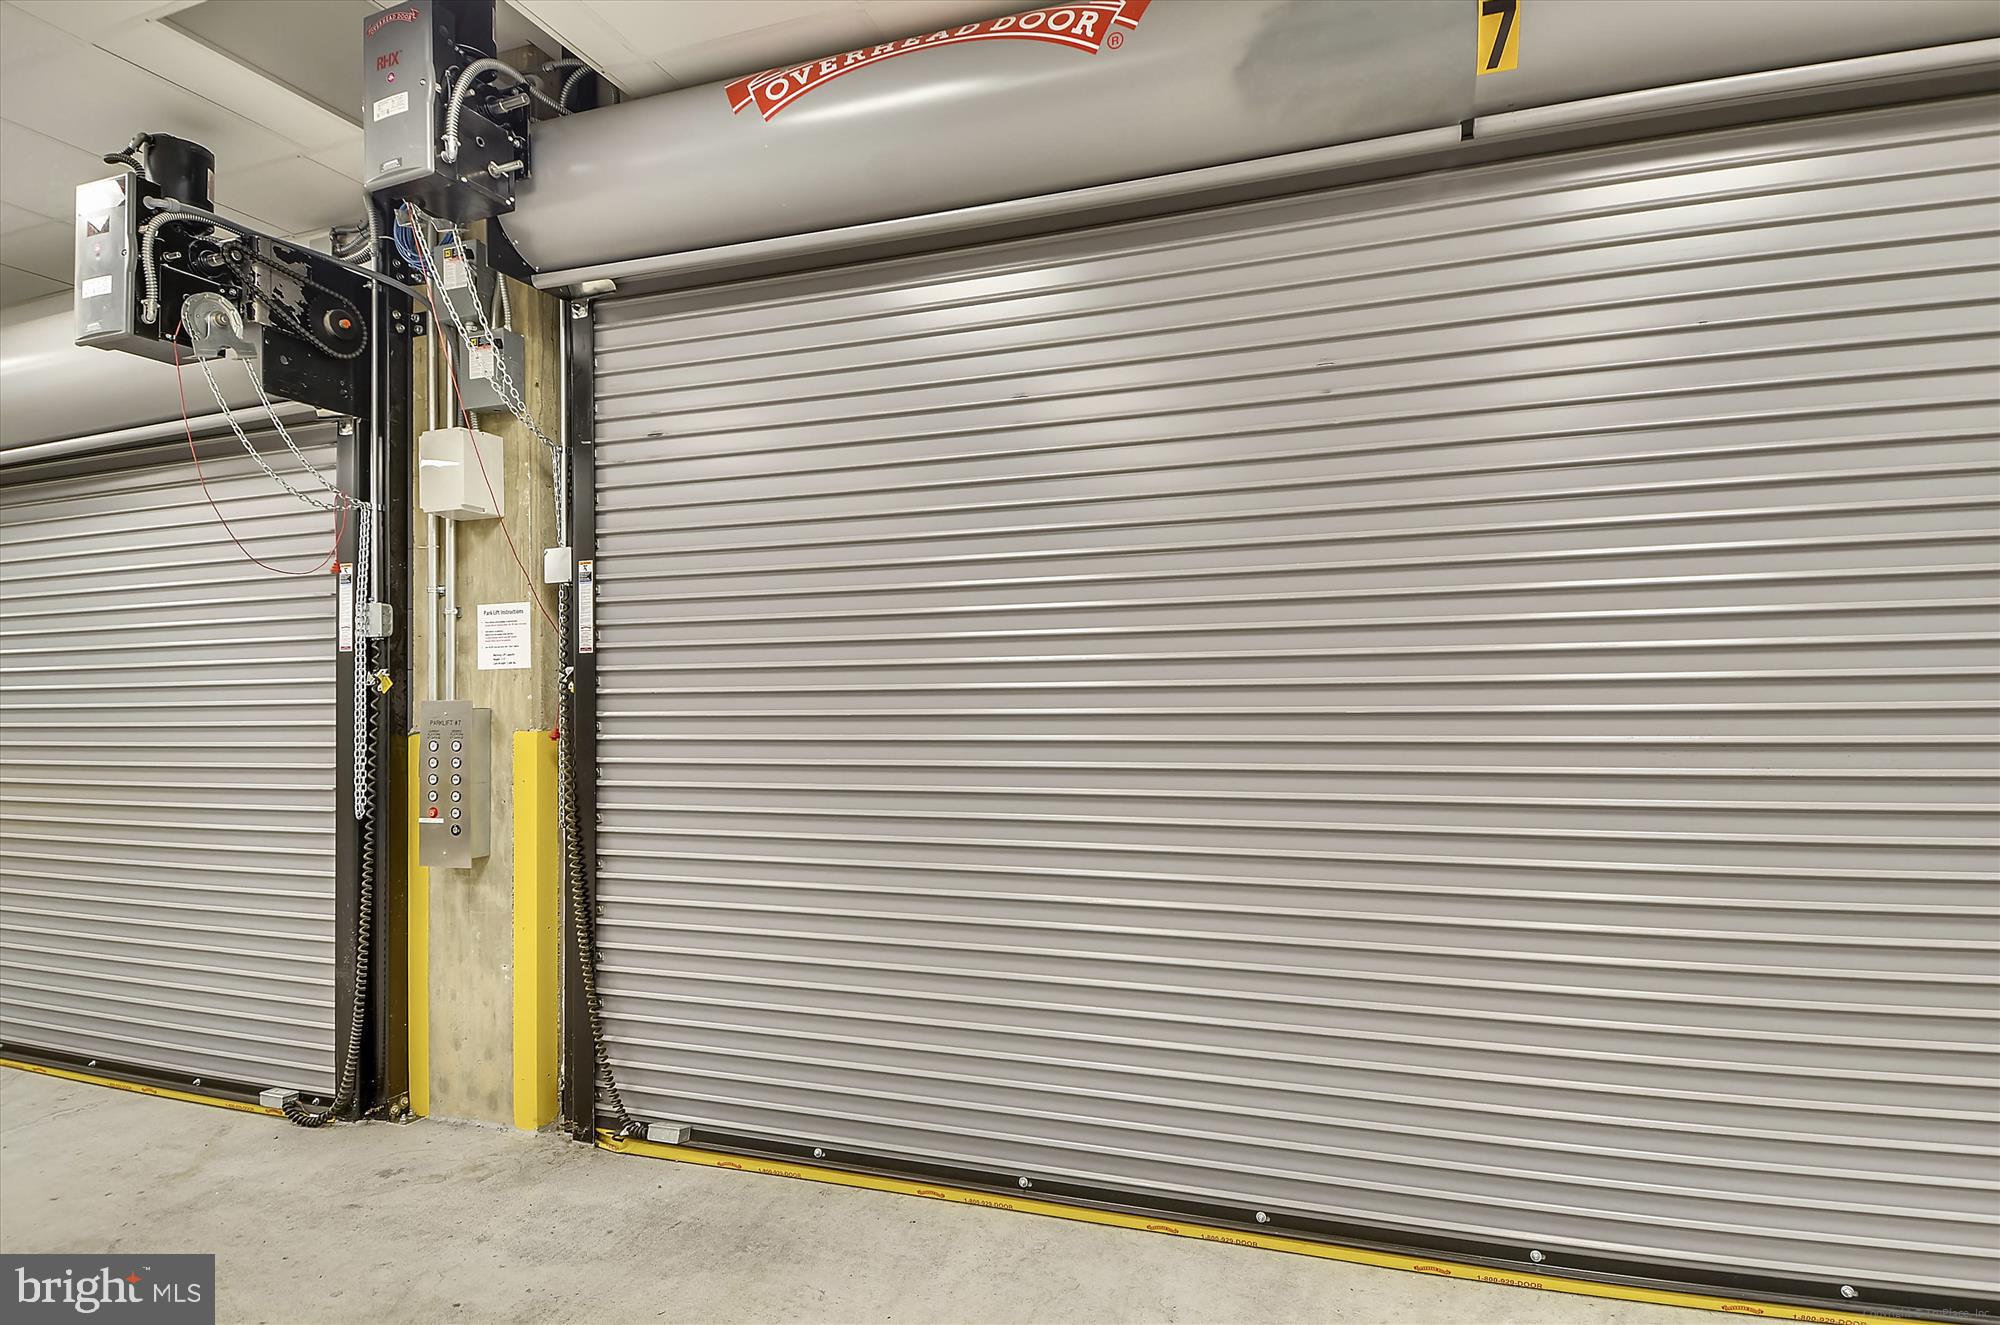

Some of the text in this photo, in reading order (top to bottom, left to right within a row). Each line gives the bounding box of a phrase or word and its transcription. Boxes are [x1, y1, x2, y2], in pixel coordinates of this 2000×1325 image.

[377, 50, 399, 71] RHX
[764, 22, 981, 101] OVERHEAD
[988, 9, 1099, 38] DOOR
[1482, 0, 1517, 70] 7
